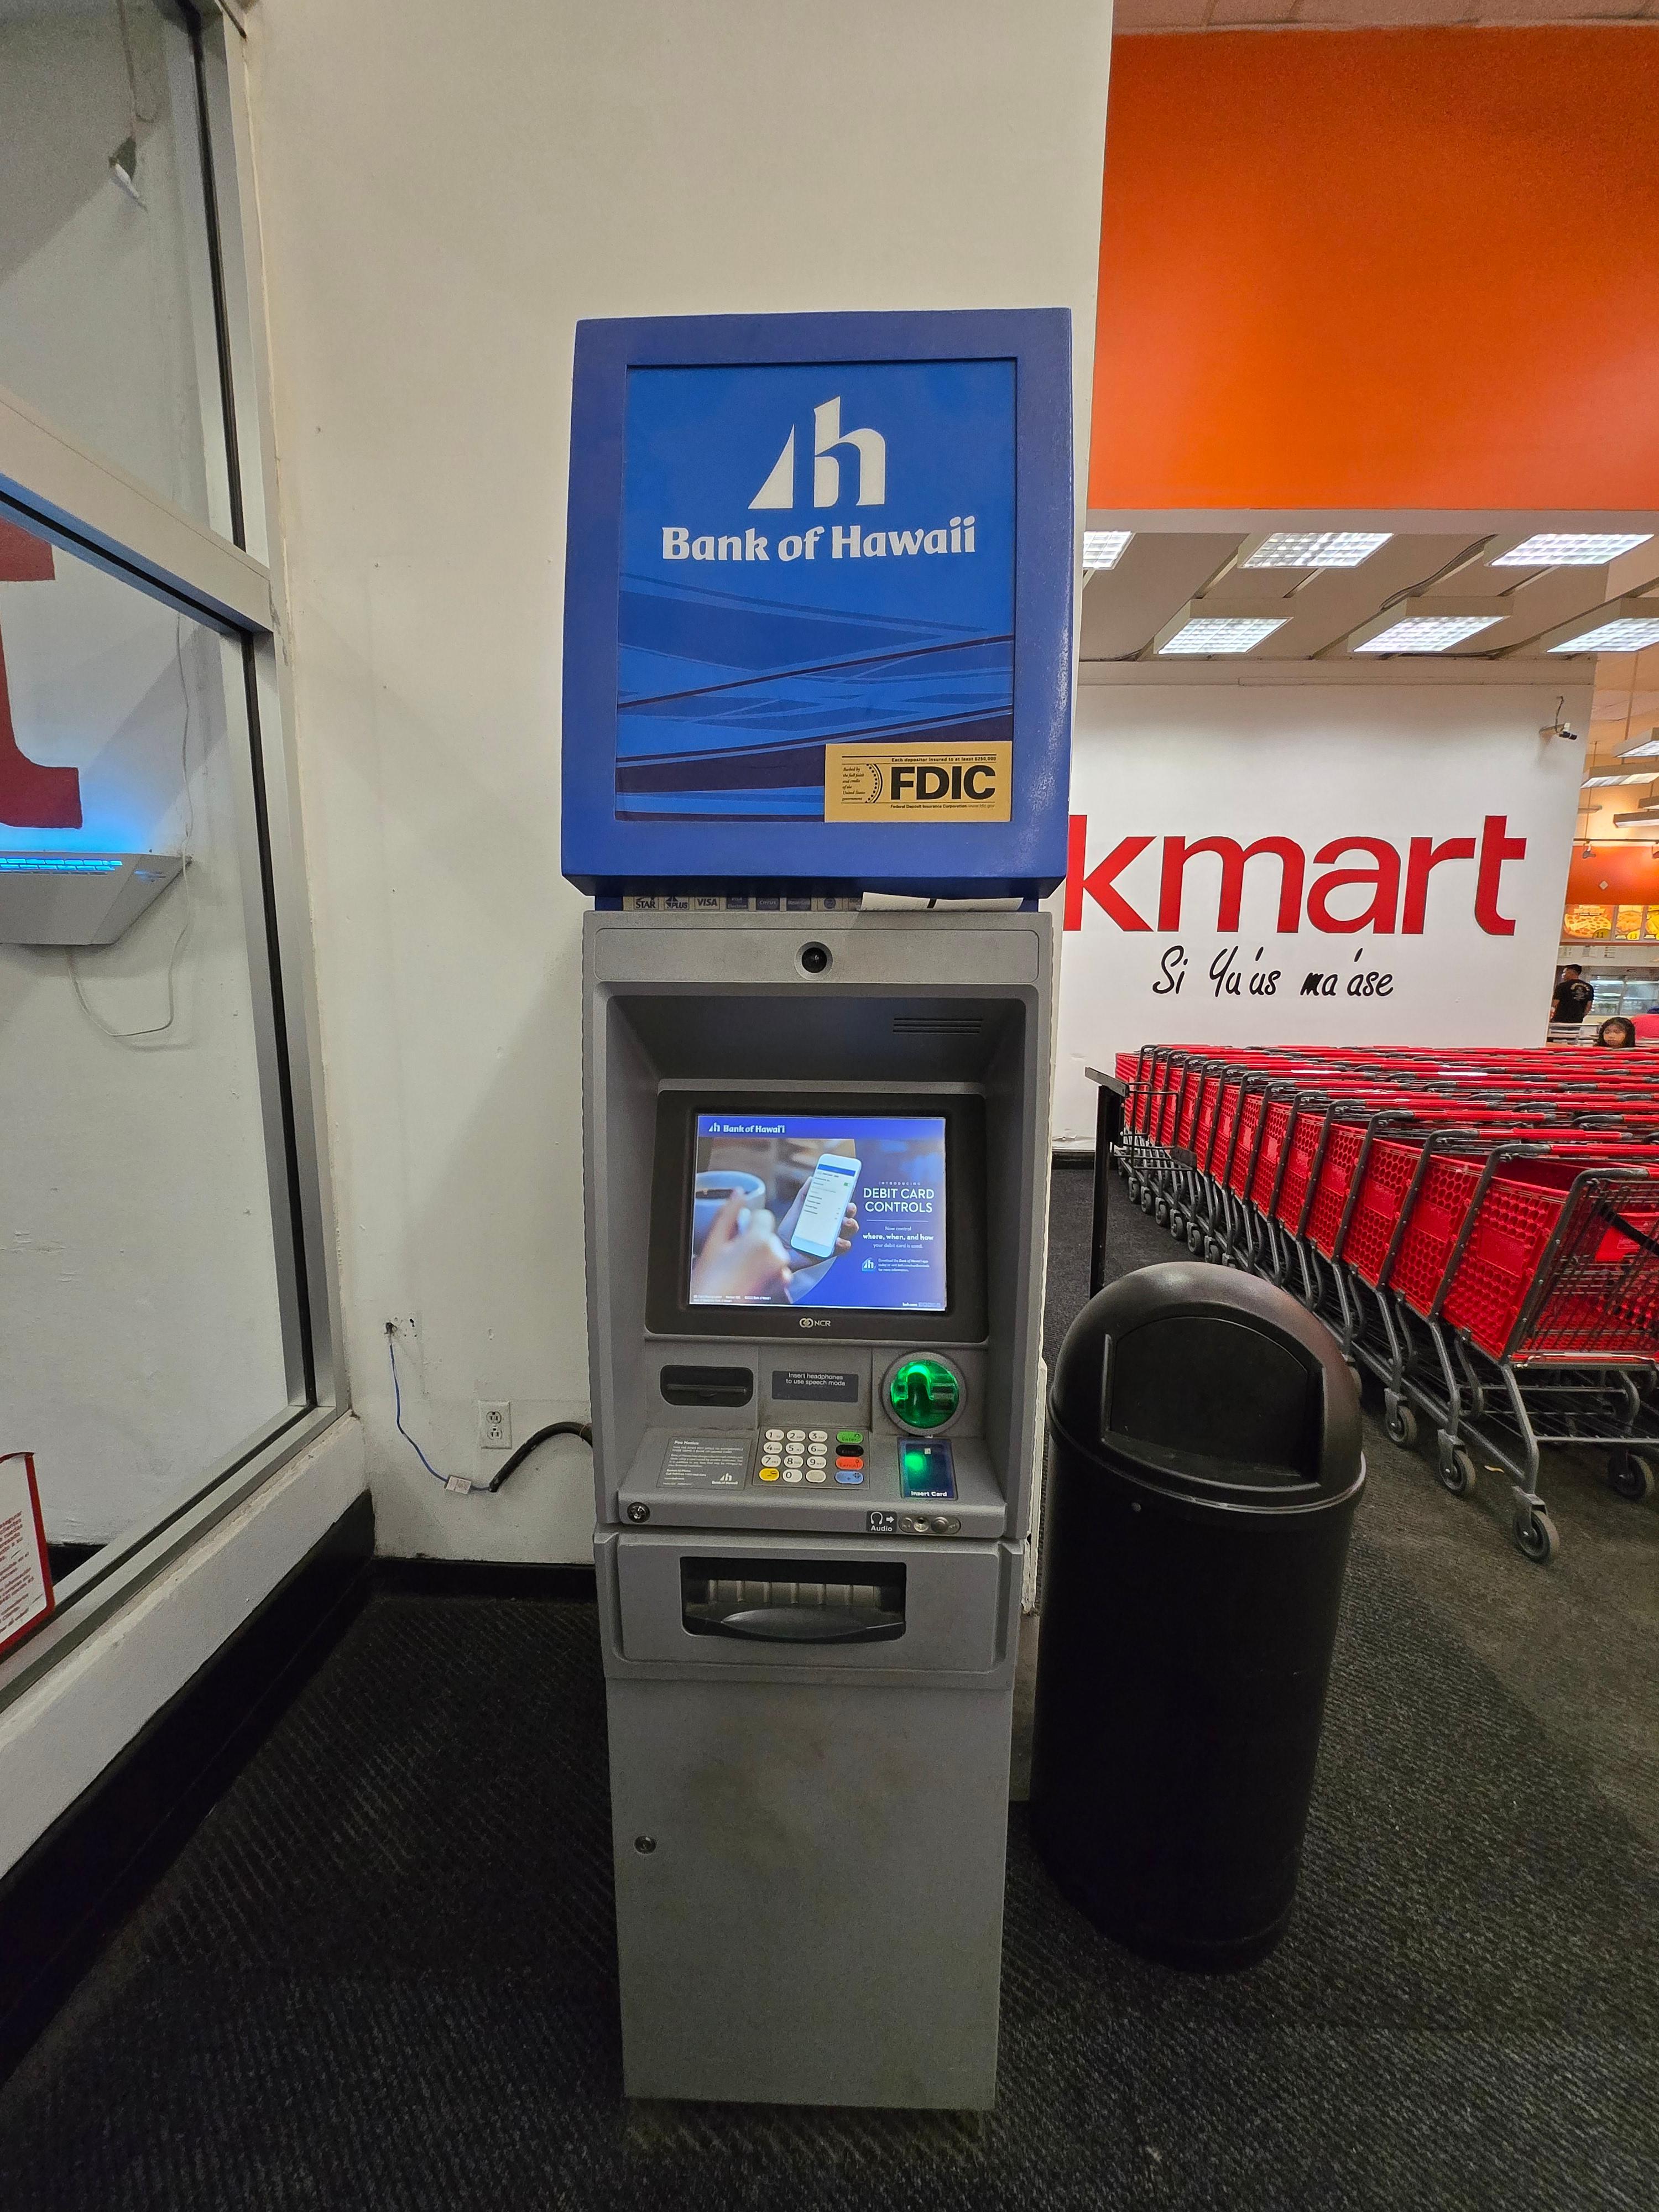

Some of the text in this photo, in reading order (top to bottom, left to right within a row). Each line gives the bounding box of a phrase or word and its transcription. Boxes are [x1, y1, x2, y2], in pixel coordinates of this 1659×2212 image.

[662, 515, 975, 562] Bank of Hawaii
[891, 764, 996, 800] FDIC
[1063, 814, 1527, 936] kmart
[697, 898, 717, 906] VISA
[1152, 945, 1188, 995] Si
[723, 1124, 744, 1133] Bank
[745, 1125, 755, 1133] of
[863, 1187, 935, 1199] DEBIT CARD
[865, 1201, 933, 1213] CONTROLS
[863, 1232, 885, 1240] where,
